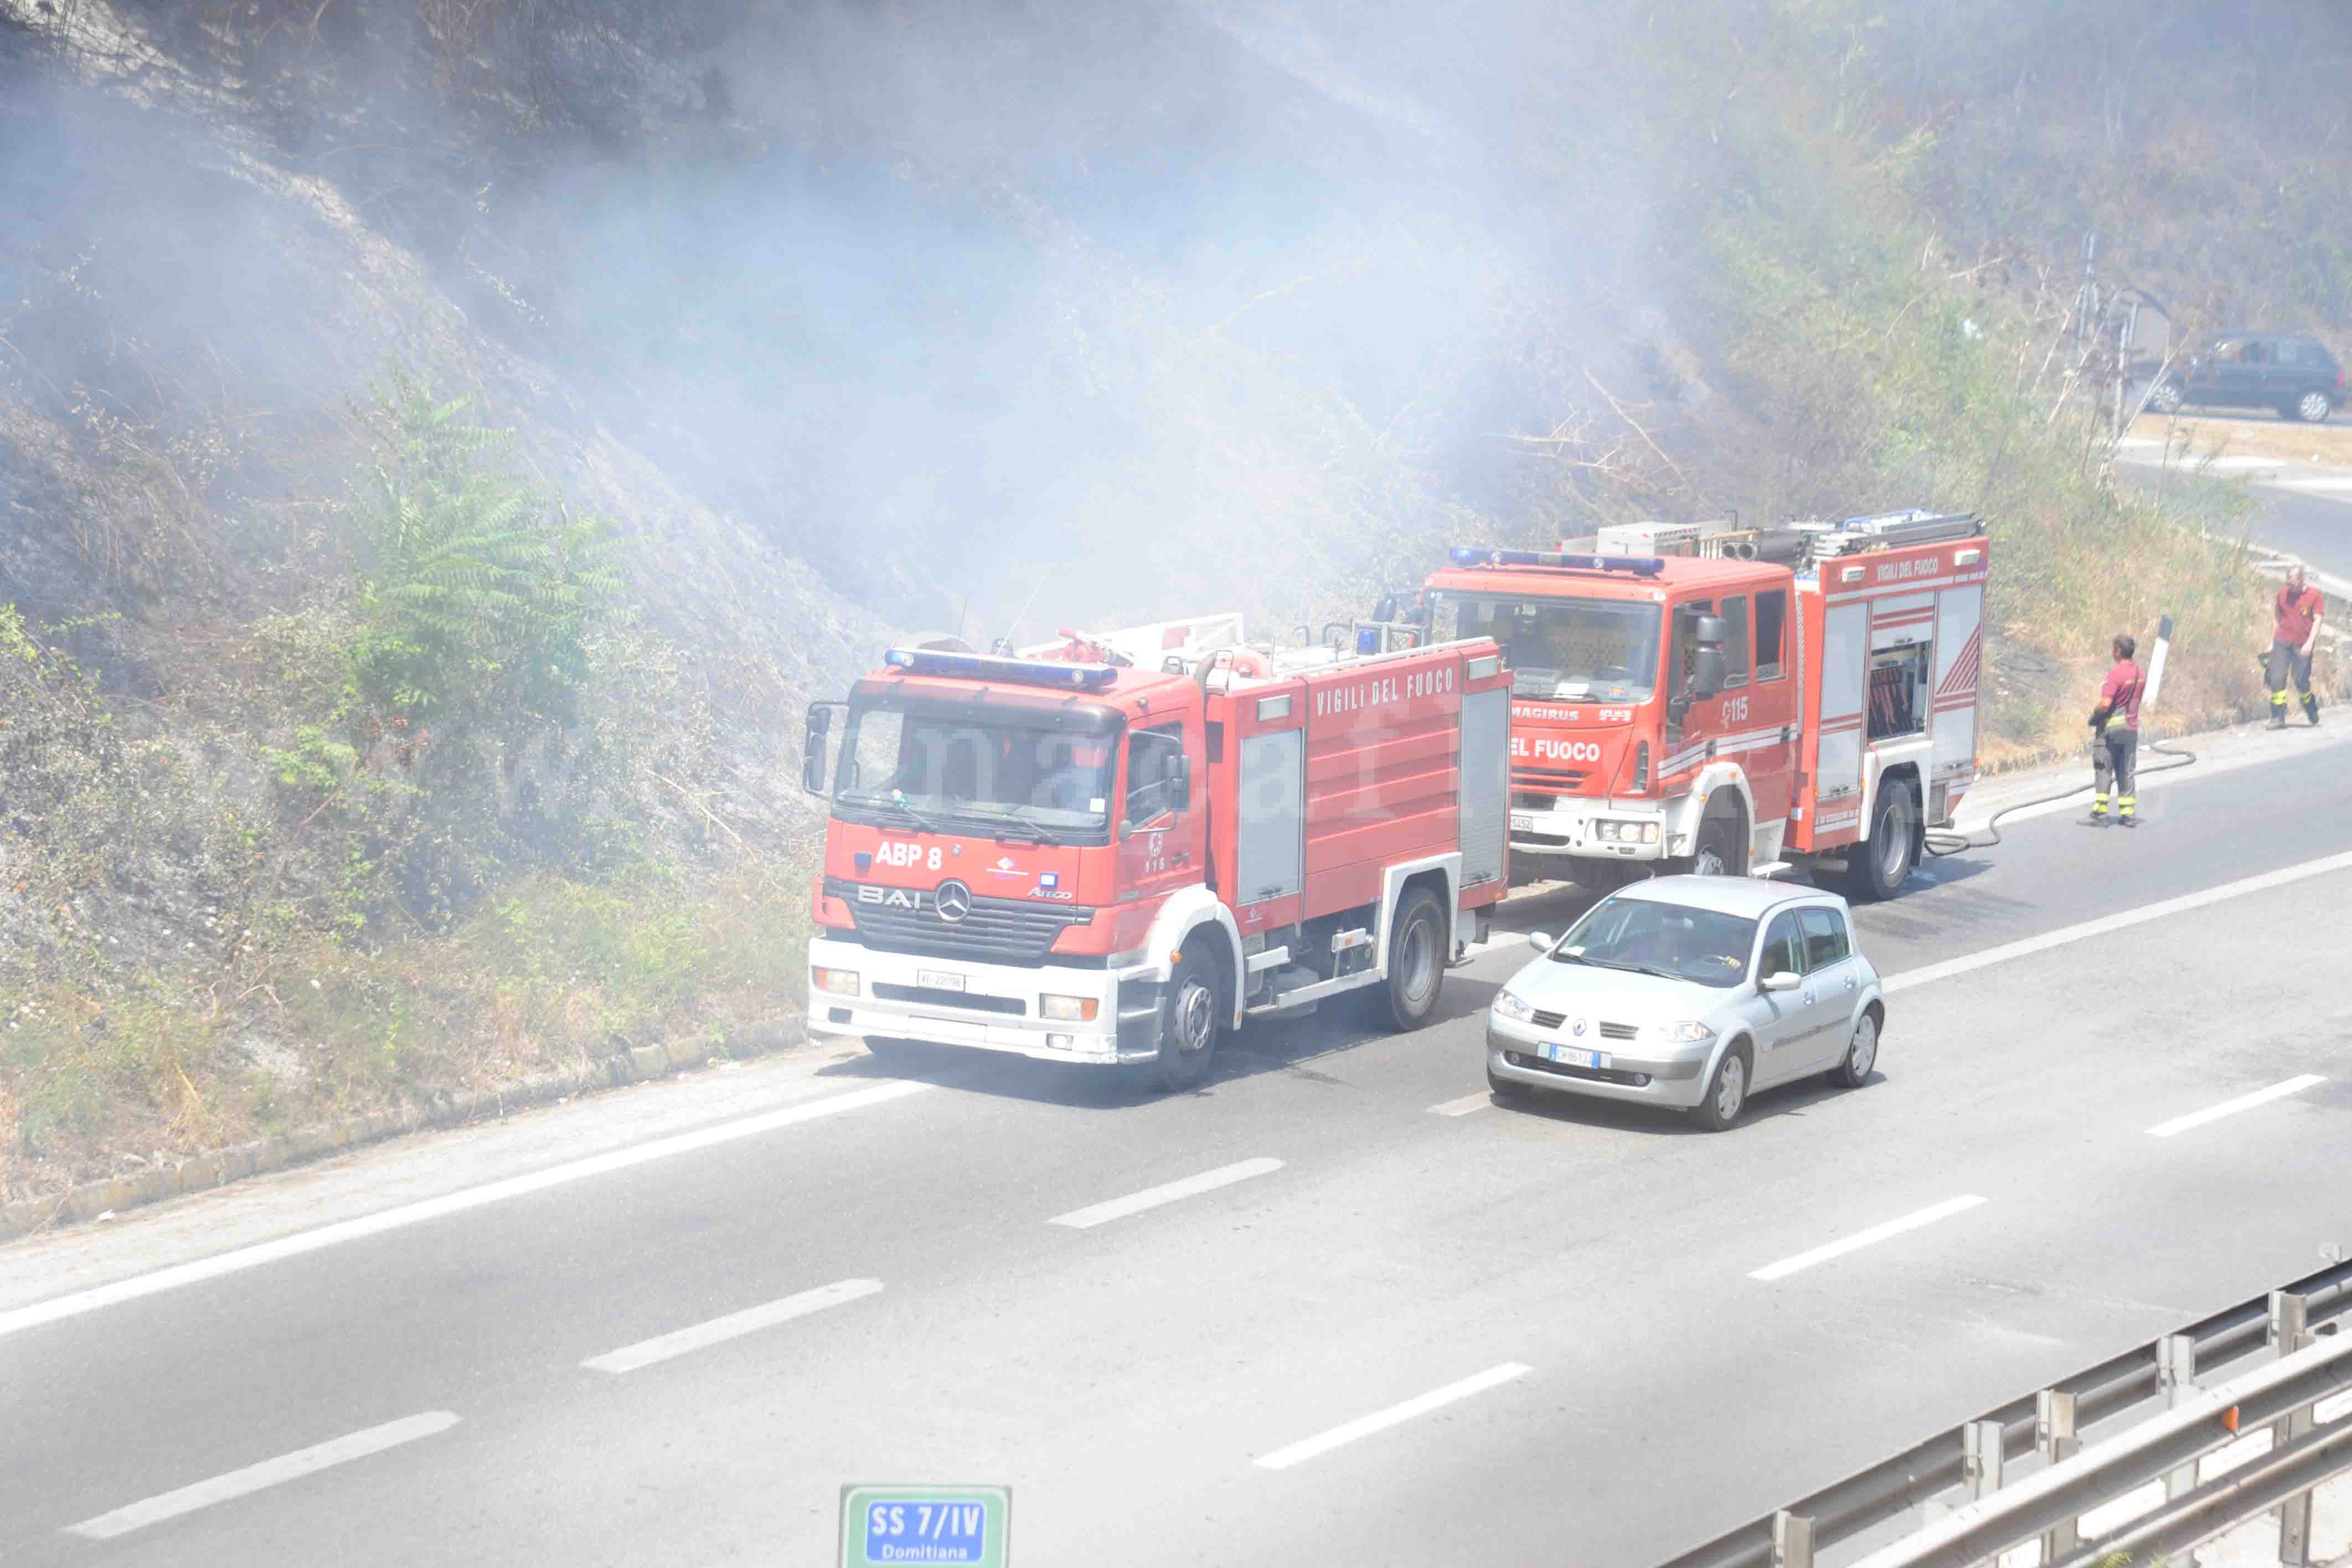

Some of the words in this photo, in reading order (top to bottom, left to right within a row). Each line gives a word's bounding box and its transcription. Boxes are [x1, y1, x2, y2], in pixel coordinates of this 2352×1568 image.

[1371, 677, 1398, 705] DEL
[1407, 667, 1453, 699] FUOCO
[1731, 695, 1750, 723] 115
[1534, 739, 1601, 762] FUOCO
[875, 840, 922, 868] ABP
[926, 846, 943, 871] 8
[858, 885, 922, 909] BAI
[871, 1505, 905, 1536] SS
[917, 1504, 981, 1541] 7/IV
[881, 1544, 968, 1560] Domitiana
